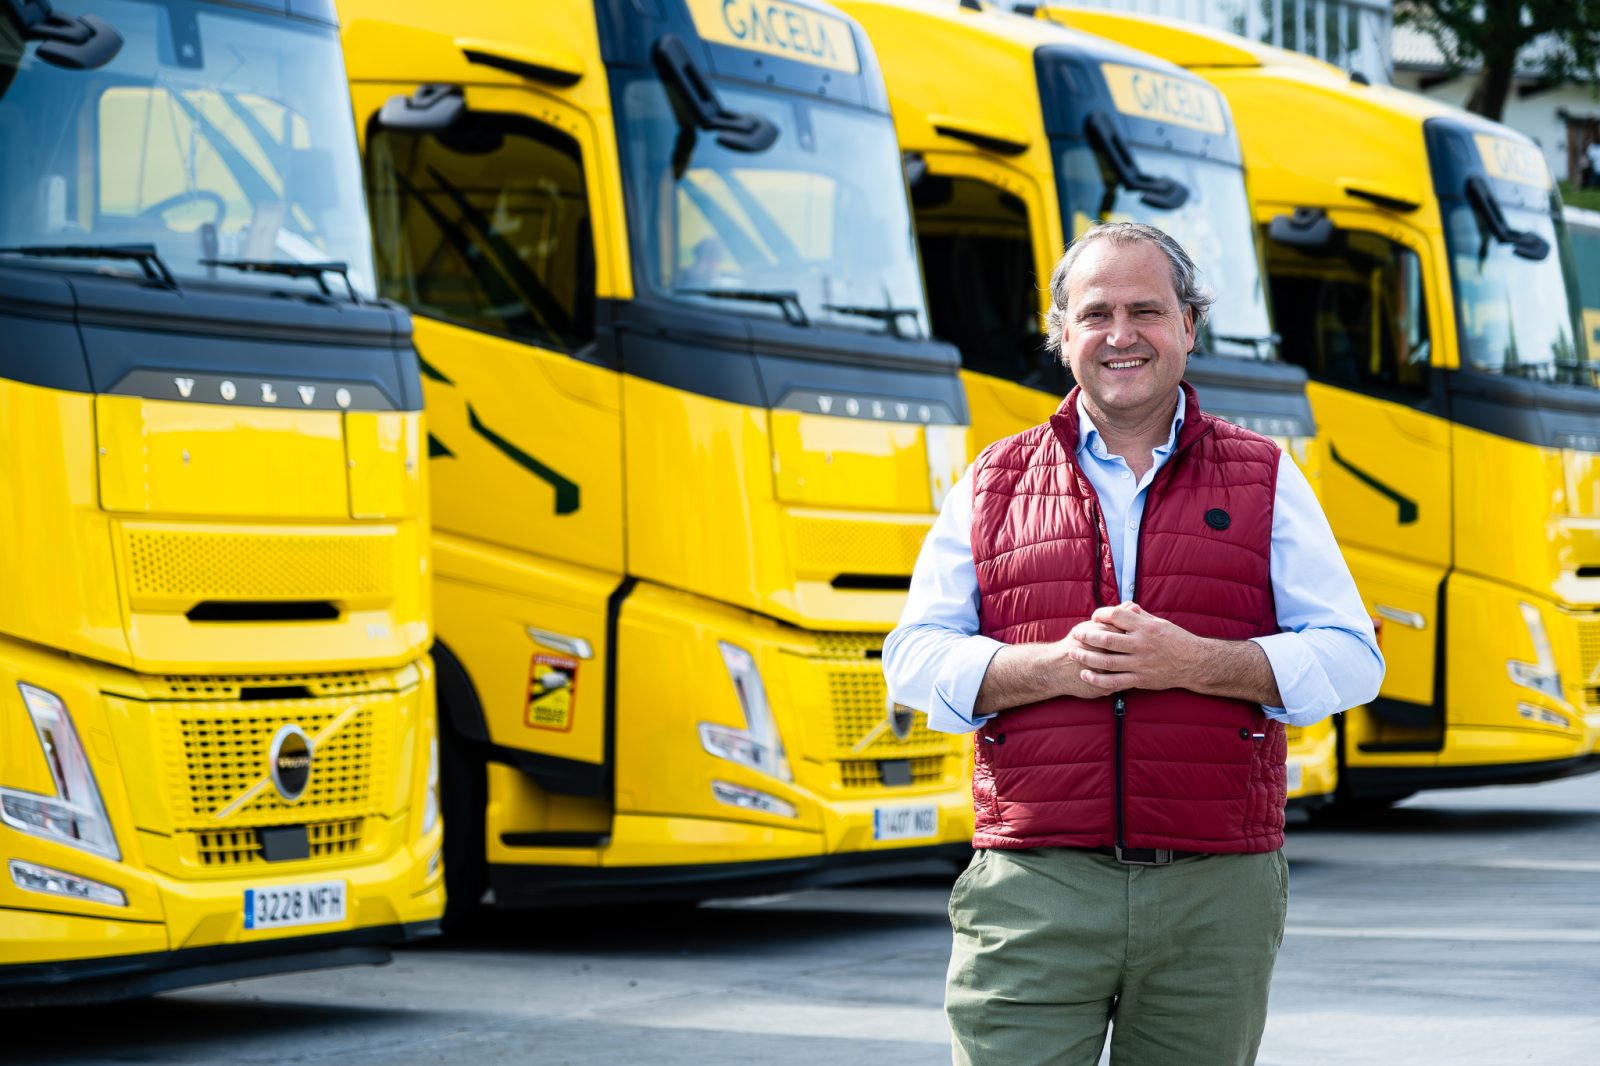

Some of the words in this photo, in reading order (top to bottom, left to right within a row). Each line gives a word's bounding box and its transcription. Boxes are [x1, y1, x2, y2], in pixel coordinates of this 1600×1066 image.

[721, 0, 838, 64] GACELA
[174, 377, 351, 408] VOLVO
[817, 395, 931, 423] VOLVO
[258, 891, 304, 922] 3228
[308, 887, 342, 917] NFH
